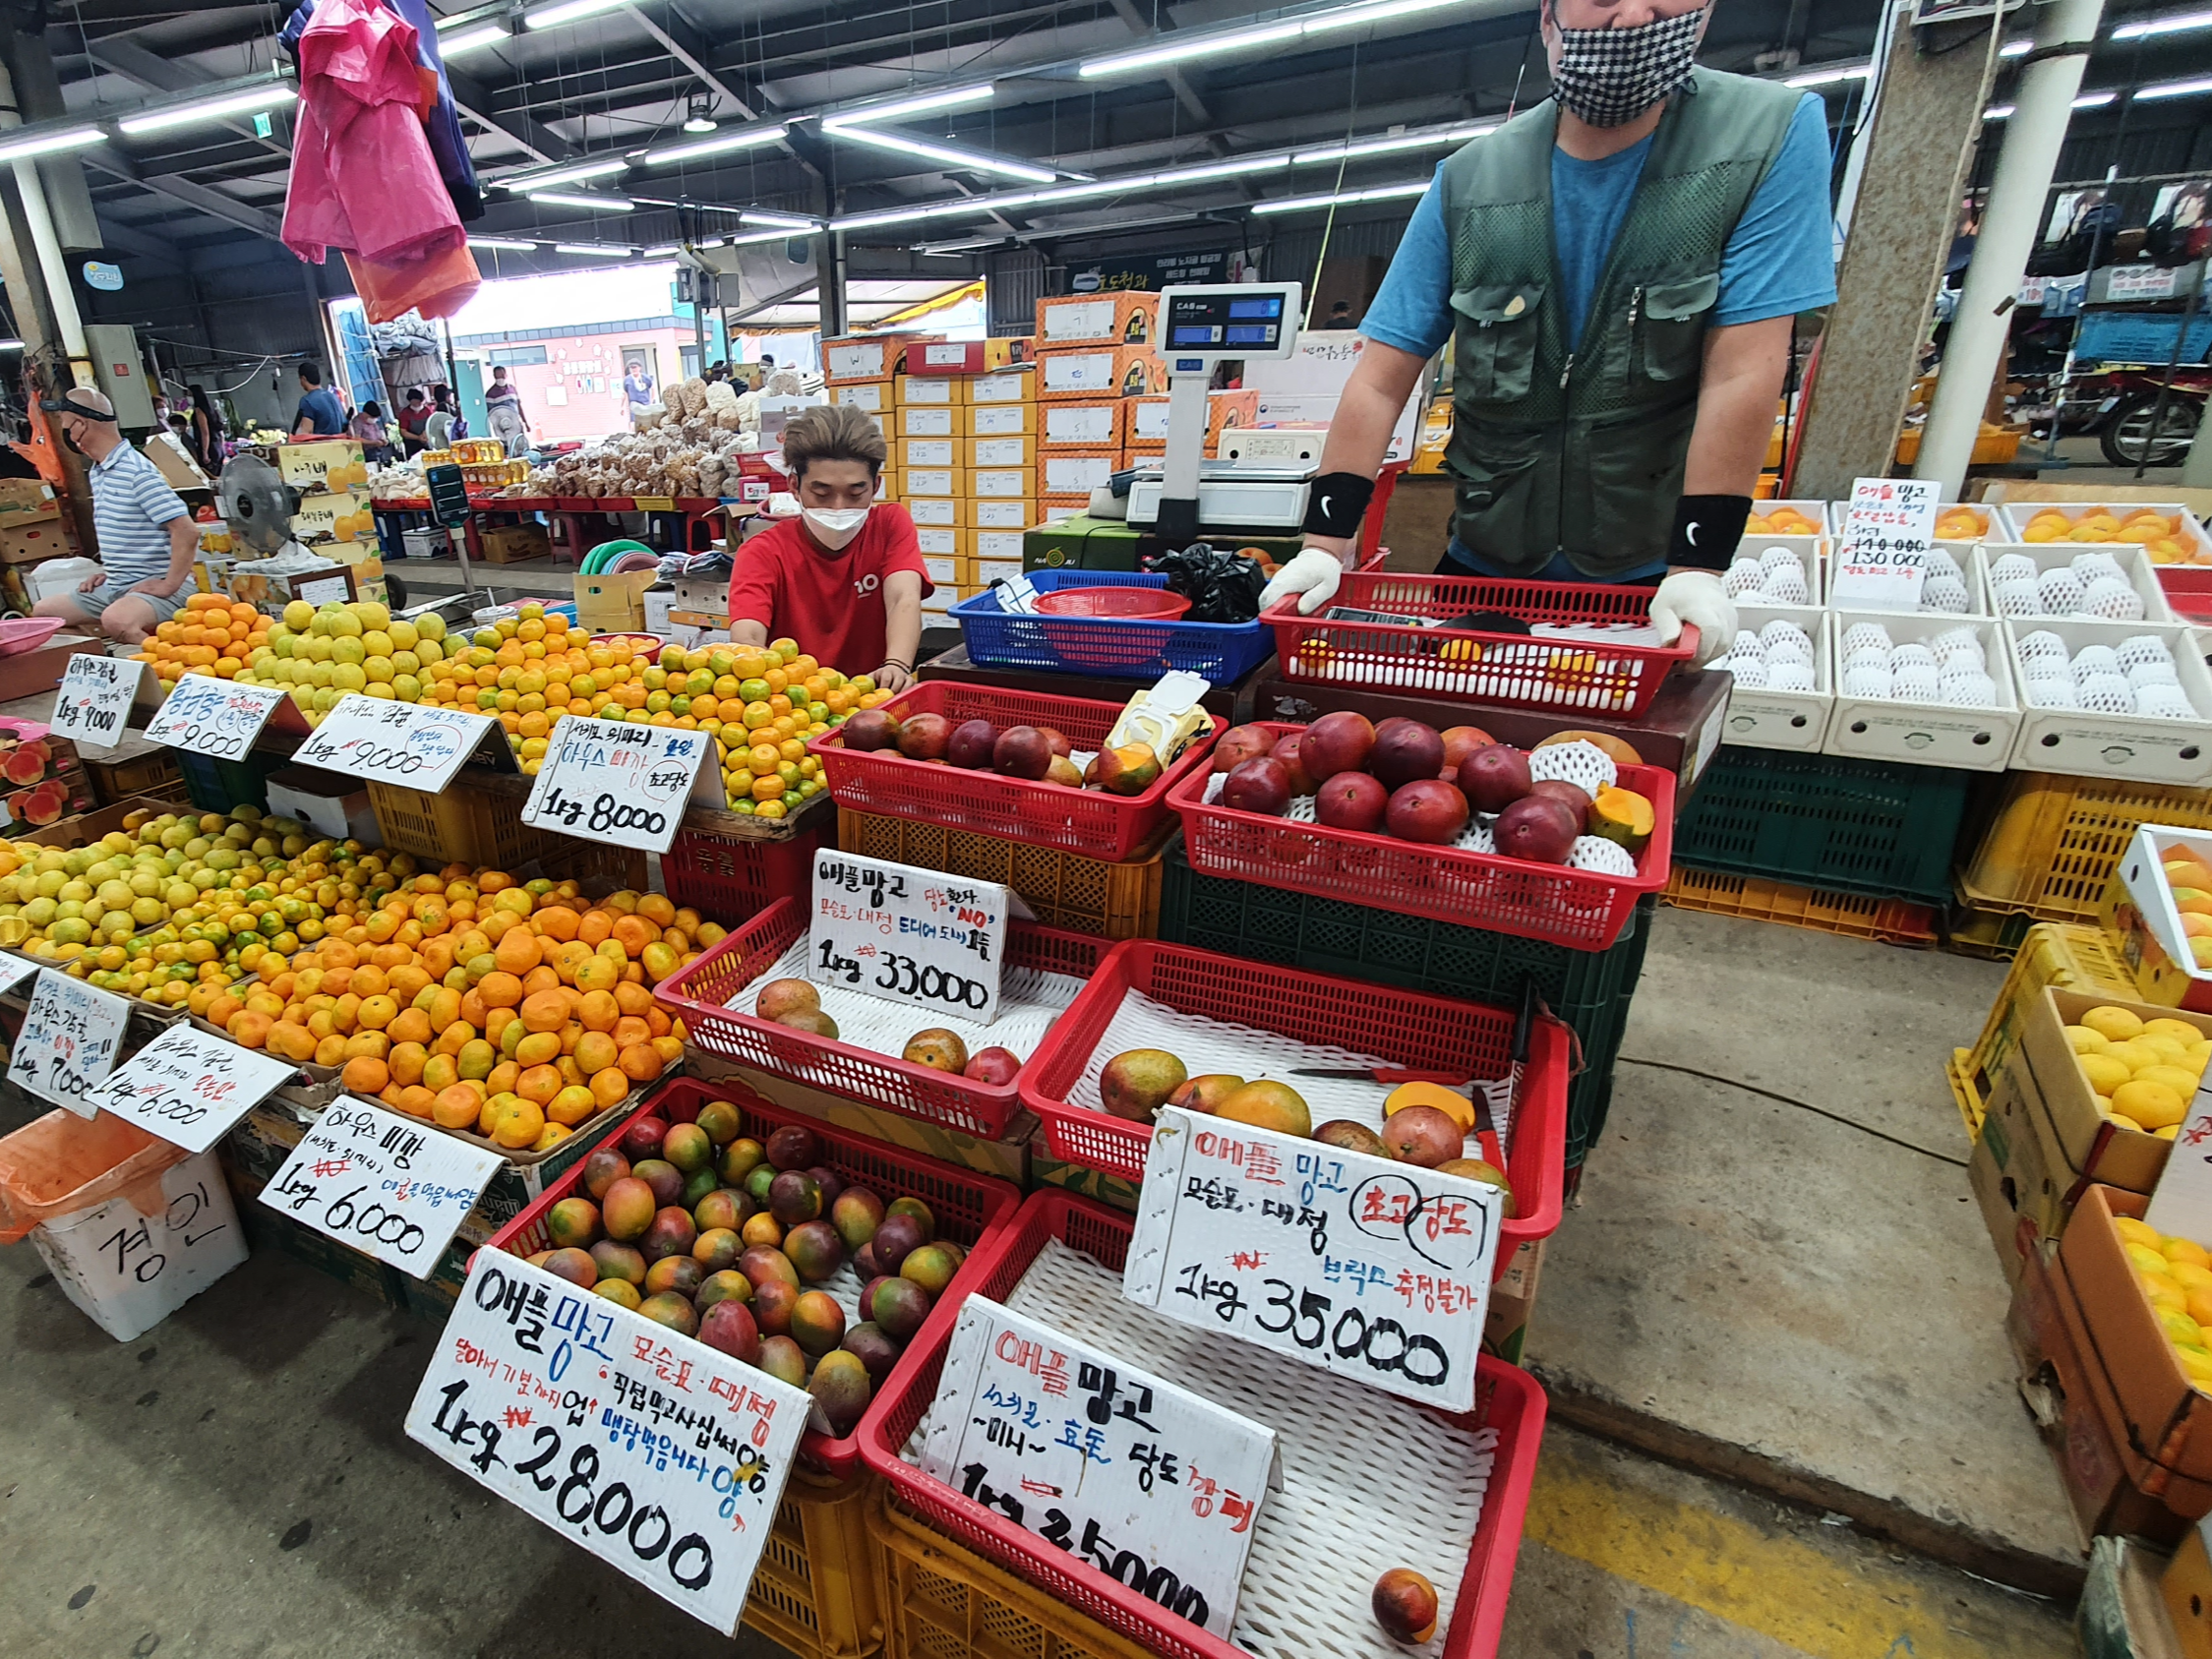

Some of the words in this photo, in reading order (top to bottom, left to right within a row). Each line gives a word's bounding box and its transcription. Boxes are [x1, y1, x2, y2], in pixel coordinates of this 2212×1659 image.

[1176, 302, 1195, 311] CAS
[1897, 484, 1929, 503] 망고
[854, 573, 879, 593] 10
[56, 695, 82, 727] 1kg
[167, 678, 226, 722] 황금향
[302, 732, 339, 762] 1kg
[562, 739, 606, 771] 하우스
[540, 787, 587, 826] 1kg
[899, 917, 936, 939] 드디어
[818, 939, 864, 982] 1kg
[152, 1033, 200, 1058] 하우스
[92, 1071, 138, 1106] 1kg
[326, 1103, 377, 1140] 하우스
[273, 1162, 323, 1210] 1kg
[1193, 1131, 1286, 1187] 애플
[1295, 1154, 1349, 1206] 망고
[1261, 1199, 1329, 1256] 대정
[1175, 1263, 1248, 1322] 1kg
[1323, 1255, 1395, 1296] 브릭스
[994, 1329, 1072, 1399] 애플
[1077, 1361, 1163, 1435] 망고
[431, 1378, 508, 1475] 1kg
[1127, 1442, 1180, 1493] 당도
